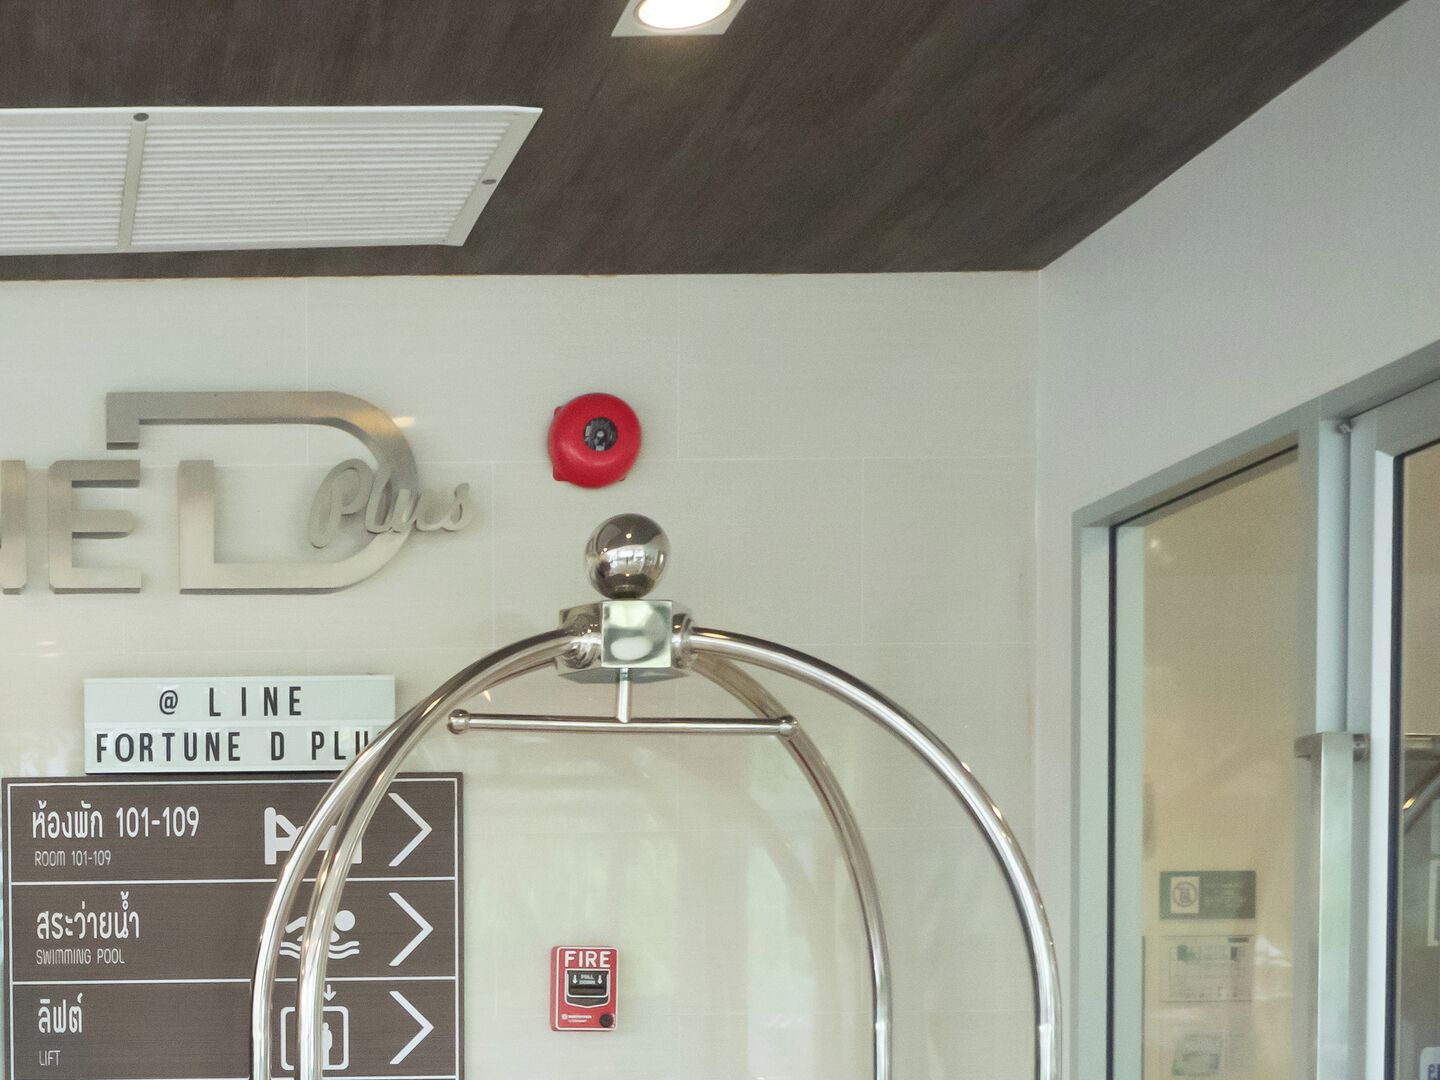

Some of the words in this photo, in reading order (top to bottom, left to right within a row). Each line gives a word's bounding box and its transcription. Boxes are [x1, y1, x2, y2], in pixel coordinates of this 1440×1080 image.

[106, 391, 419, 595] D
[308, 458, 473, 549] Plus
[159, 689, 179, 715] @
[208, 686, 302, 717] LINE
[95, 731, 241, 763] FORTUNE
[270, 731, 286, 761] D
[311, 730, 382, 761] PLU
[32, 799, 104, 839] ห้องพัก
[115, 806, 200, 838] 101-109
[34, 850, 66, 867] ROOM
[71, 849, 112, 866] 101-109
[36, 890, 140, 940] สระว่ายน้ำ
[36, 948, 92, 965] SWIMMING
[96, 948, 126, 965] POOL
[564, 950, 611, 967] FIRE
[37, 992, 84, 1034] ลิฟต์
[38, 1049, 61, 1066] LIFT
